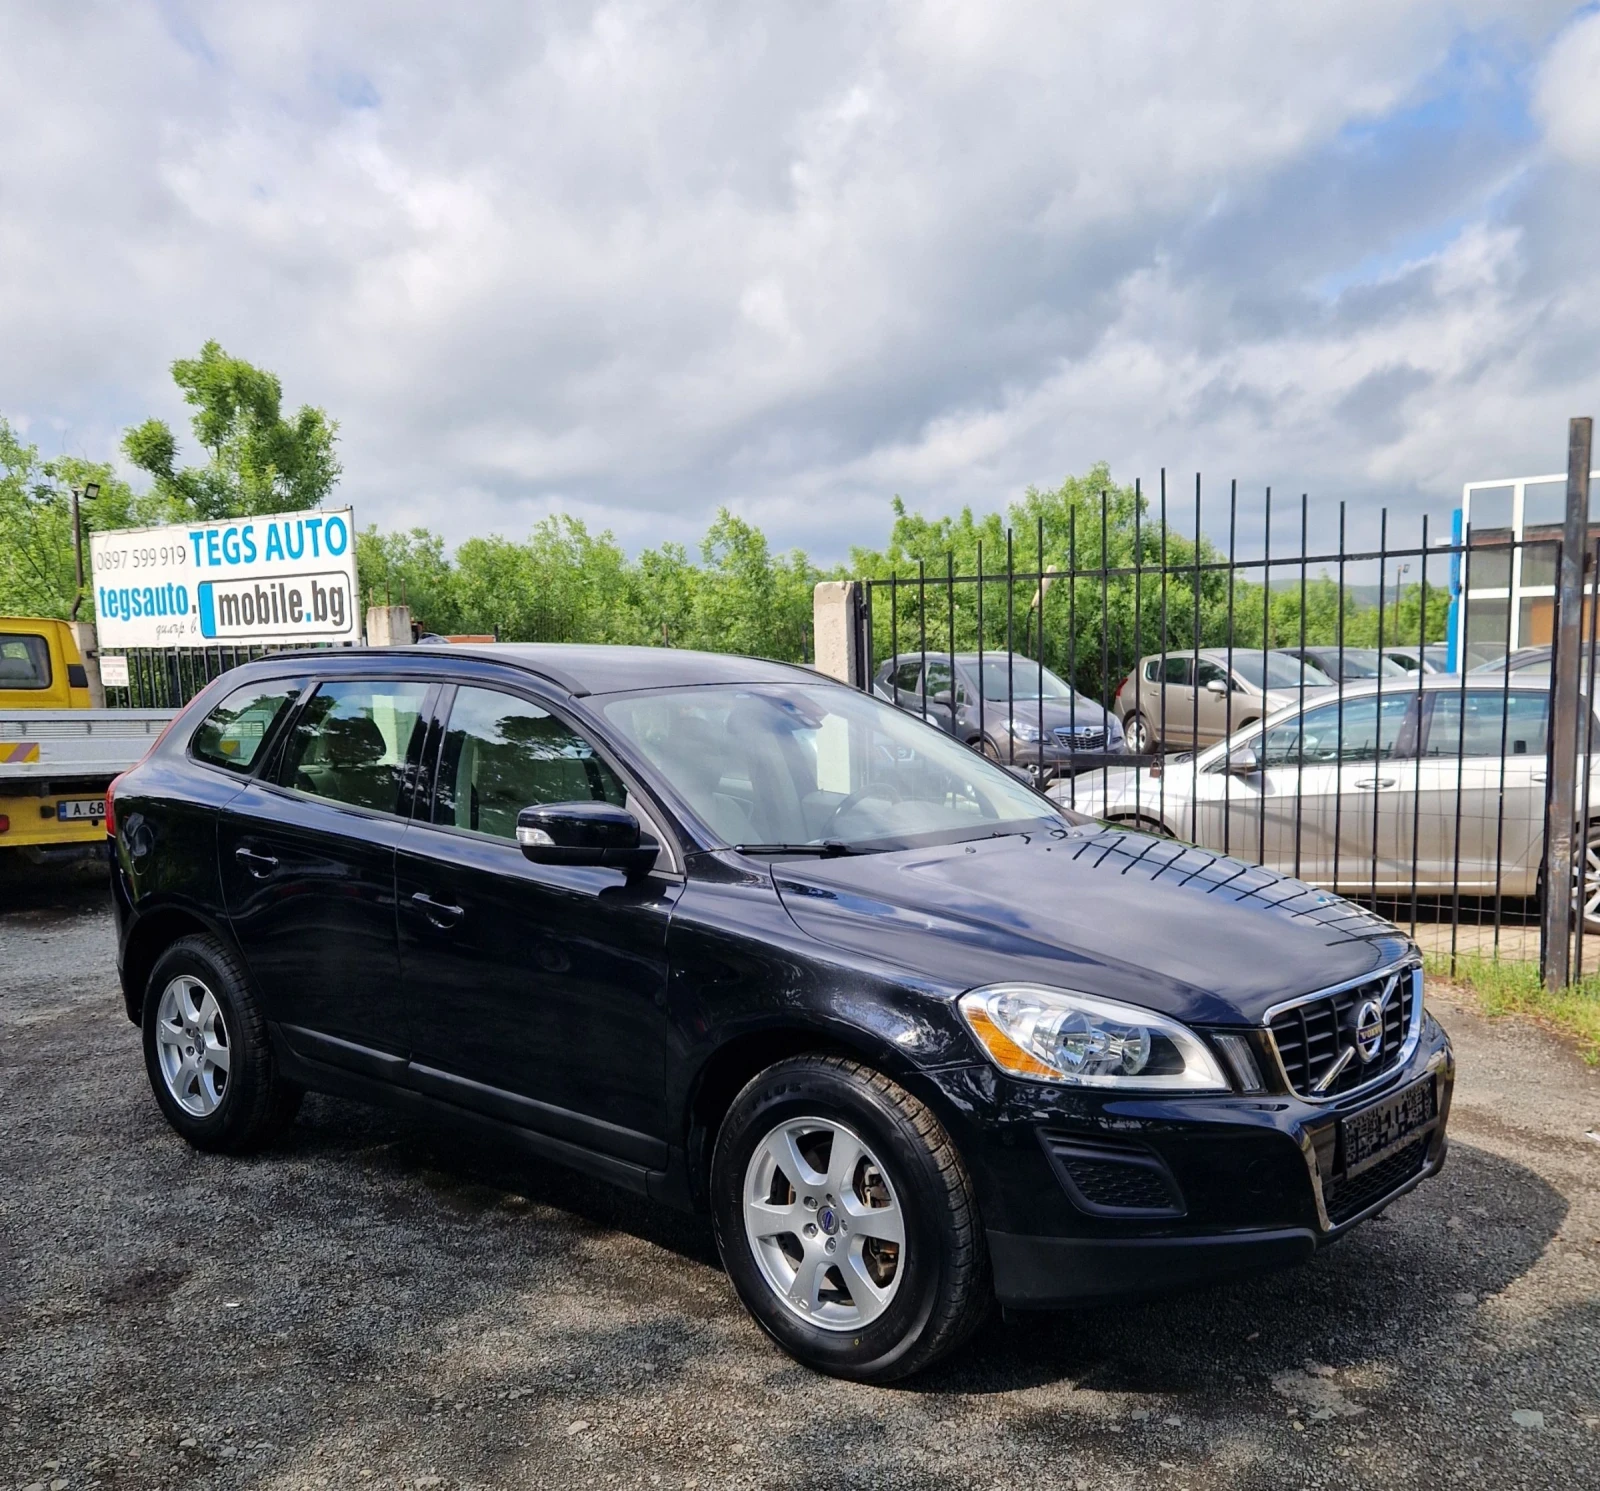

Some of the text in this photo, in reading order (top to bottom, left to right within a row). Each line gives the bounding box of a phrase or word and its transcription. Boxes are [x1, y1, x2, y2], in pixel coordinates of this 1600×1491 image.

[96, 545, 186, 571] 0897 599 919
[189, 516, 347, 567] TEGS AUTO
[217, 579, 346, 628] mobile.bg
